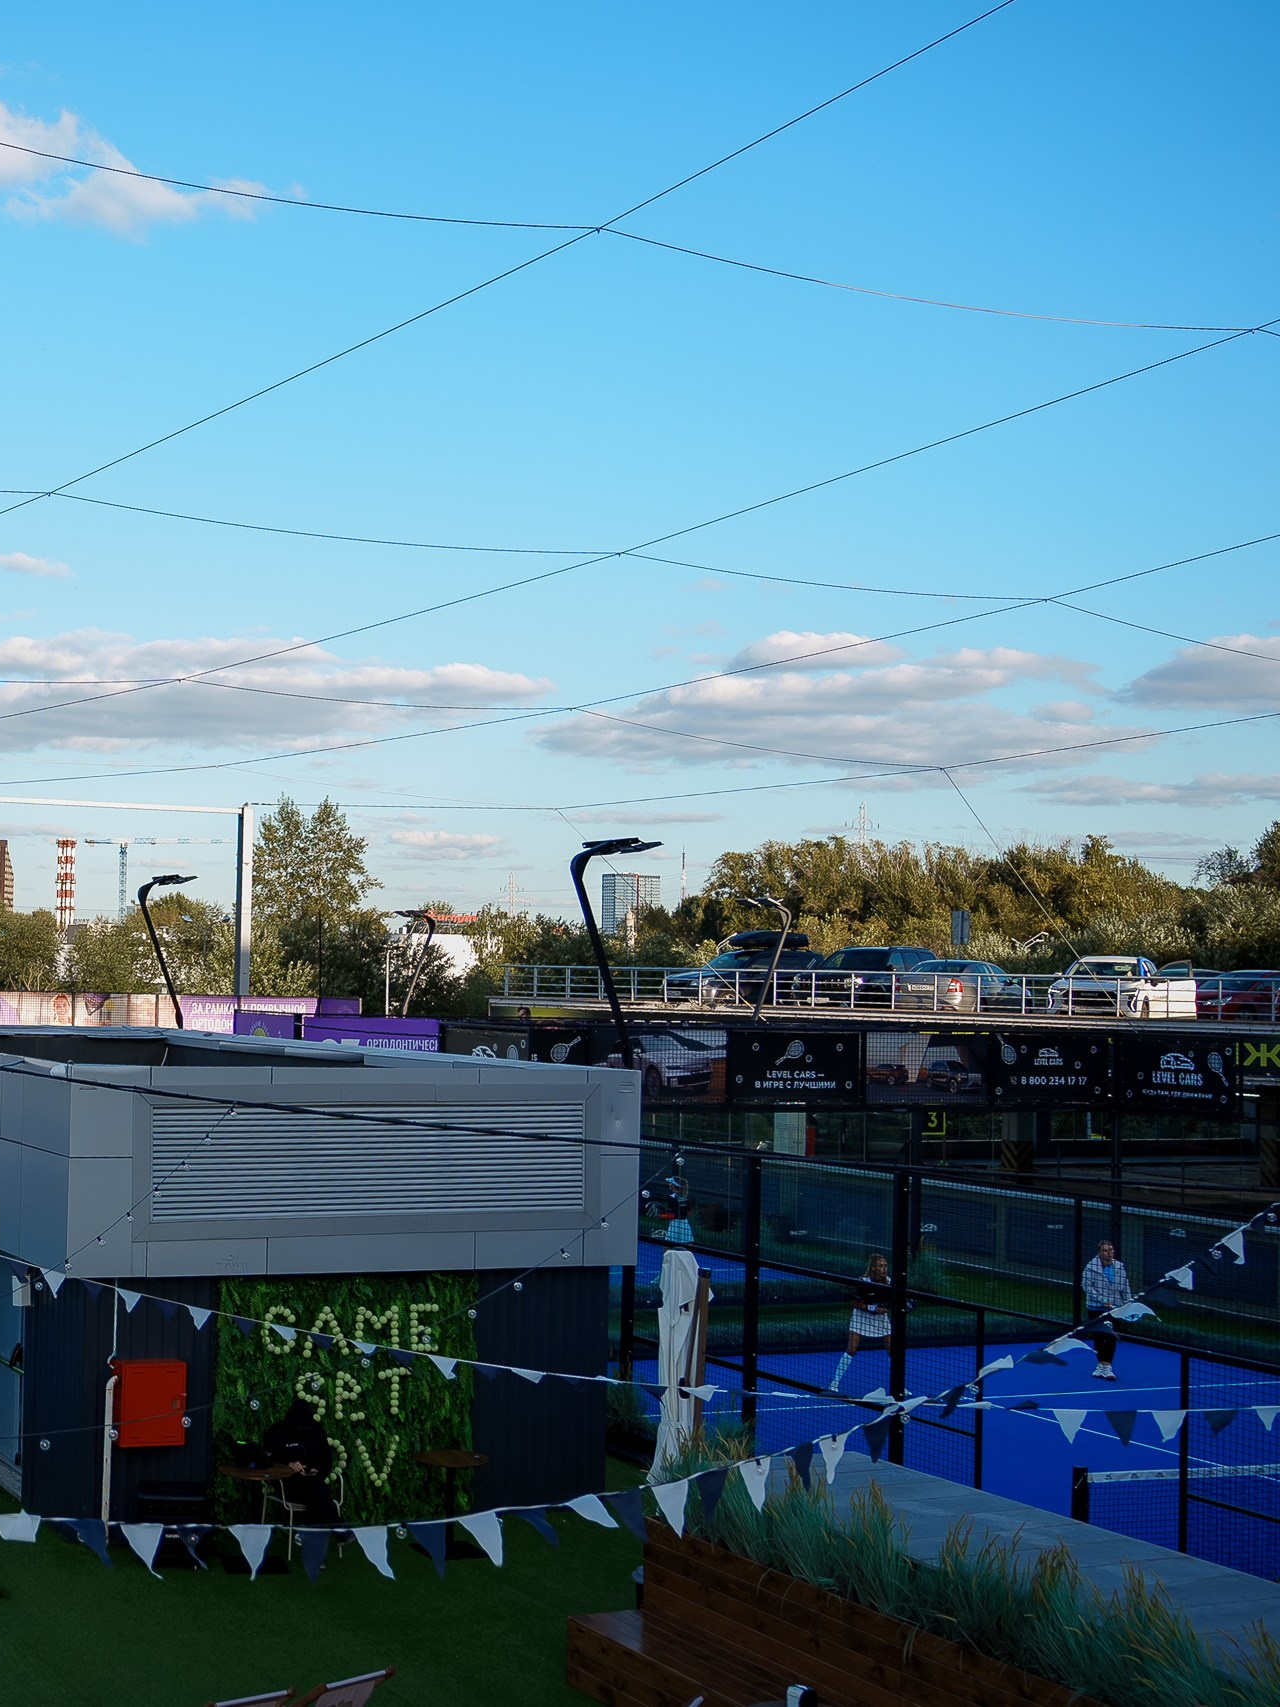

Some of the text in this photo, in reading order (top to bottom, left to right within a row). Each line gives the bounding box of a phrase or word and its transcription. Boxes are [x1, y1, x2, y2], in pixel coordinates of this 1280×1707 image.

[1033, 1058, 1063, 1066] LEVEL CARS
[766, 1070, 792, 1079] LEVEL
[793, 1070, 816, 1079] CARS
[1151, 1071, 1204, 1087] LEVEL CARS
[754, 1081, 836, 1089] В ИГРЕ С ЛУЧШИМИ
[1020, 1076, 1087, 1085] 8 800 234 17 17
[927, 1112, 938, 1127] 3
